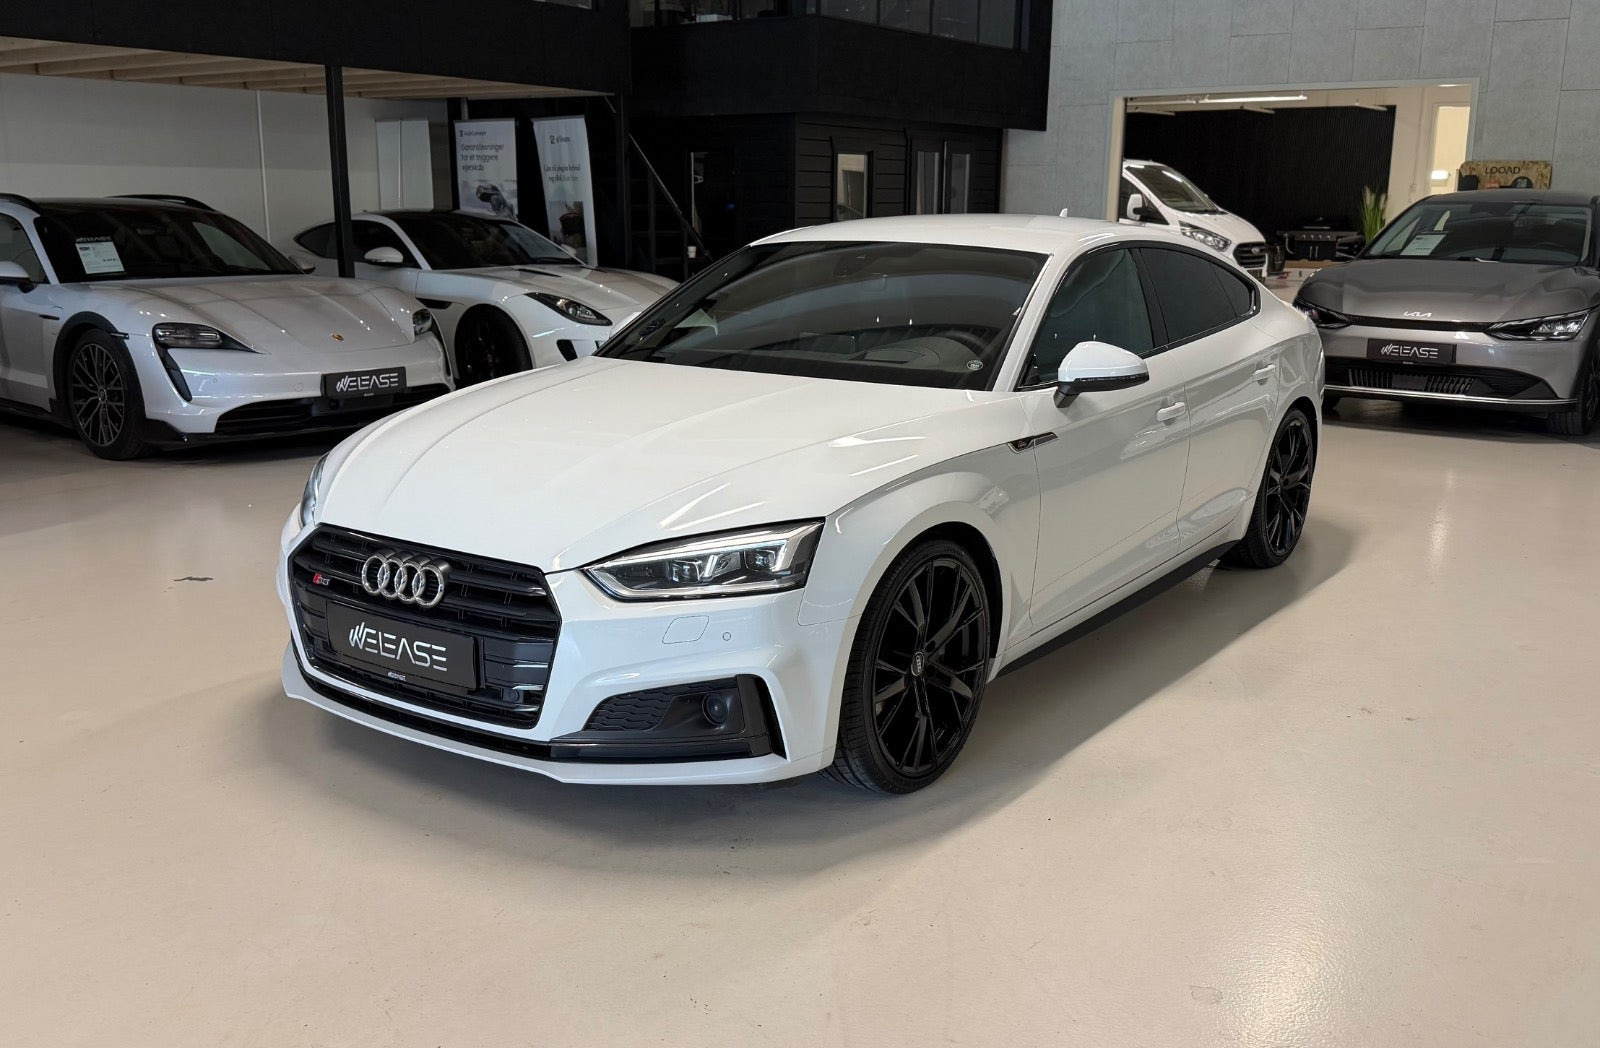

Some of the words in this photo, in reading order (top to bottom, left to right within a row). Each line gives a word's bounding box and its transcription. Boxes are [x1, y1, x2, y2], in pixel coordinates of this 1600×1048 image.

[1485, 166, 1520, 175] LOOAD
[1381, 343, 1438, 359] WELEASE
[336, 375, 399, 392] WELEASE
[349, 621, 447, 672] WELEASE
